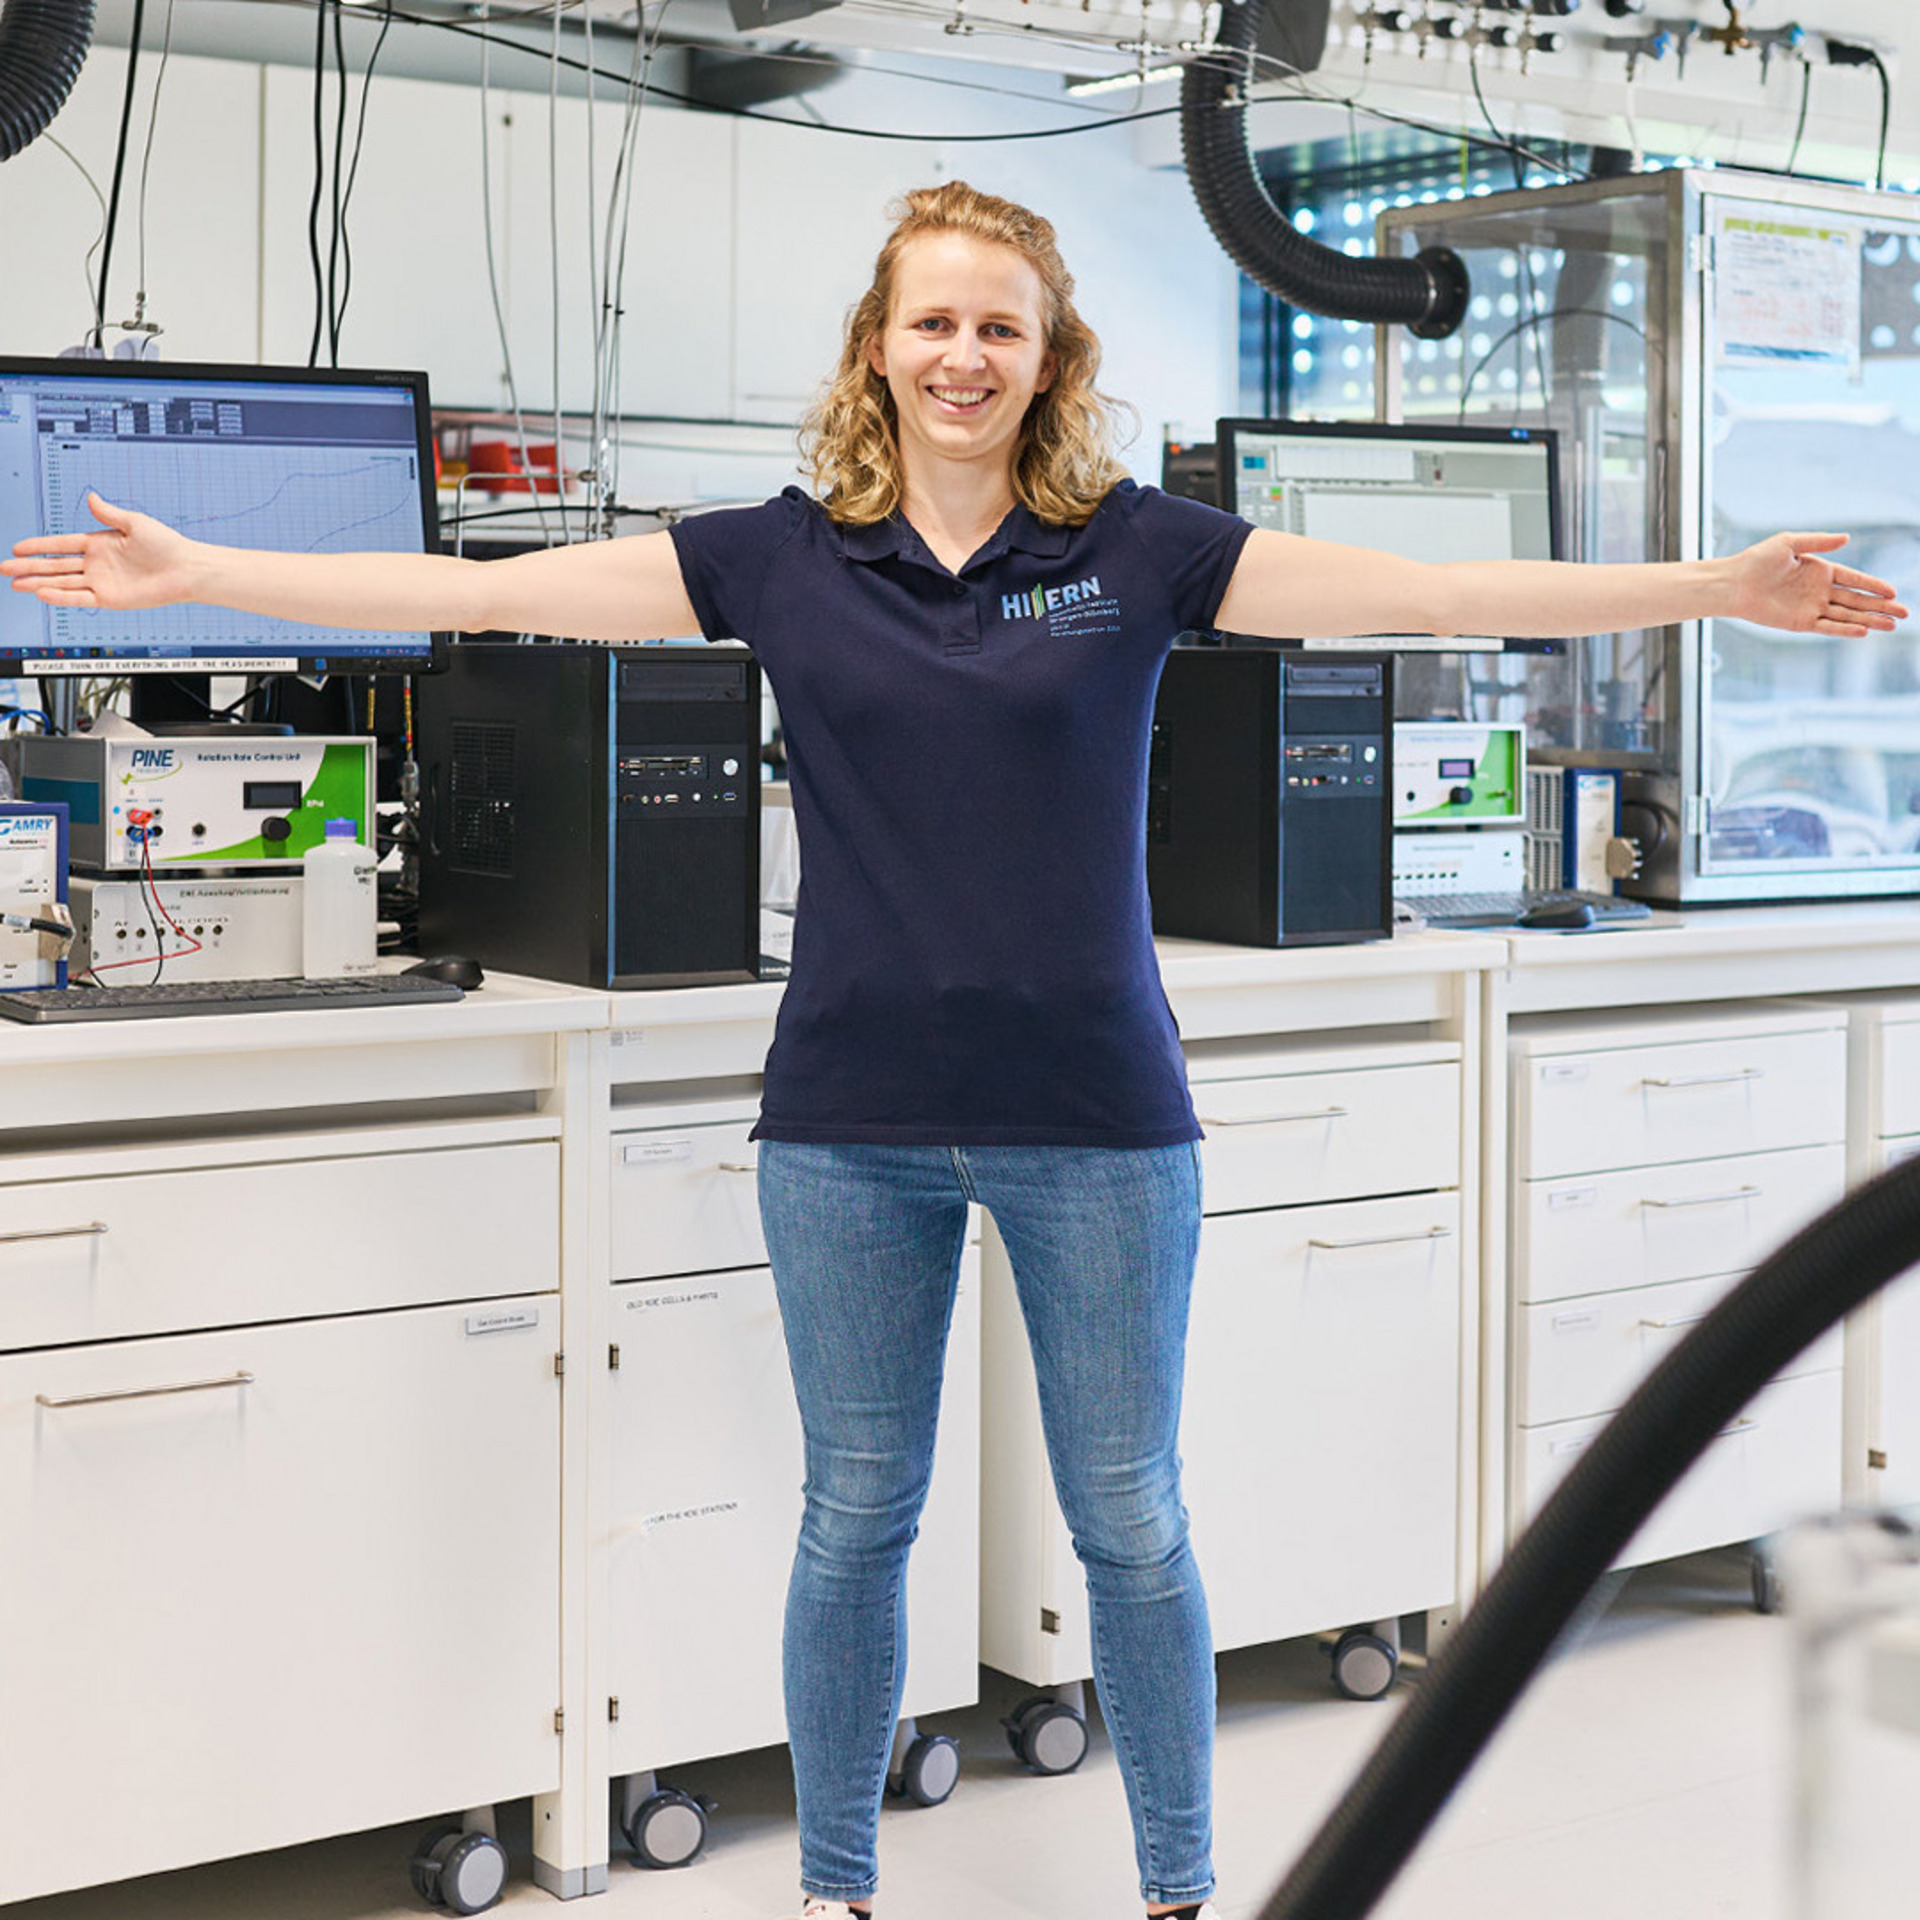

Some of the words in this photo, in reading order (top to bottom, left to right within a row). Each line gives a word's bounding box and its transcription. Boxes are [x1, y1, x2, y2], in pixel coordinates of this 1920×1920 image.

[33, 662, 64, 670] PLEASE
[115, 661, 168, 669] EVERYTHING
[131, 750, 174, 767] PINE
[198, 753, 232, 762] Rotation
[234, 753, 251, 762] Rate
[254, 752, 283, 762] Control
[285, 752, 300, 761] Unit
